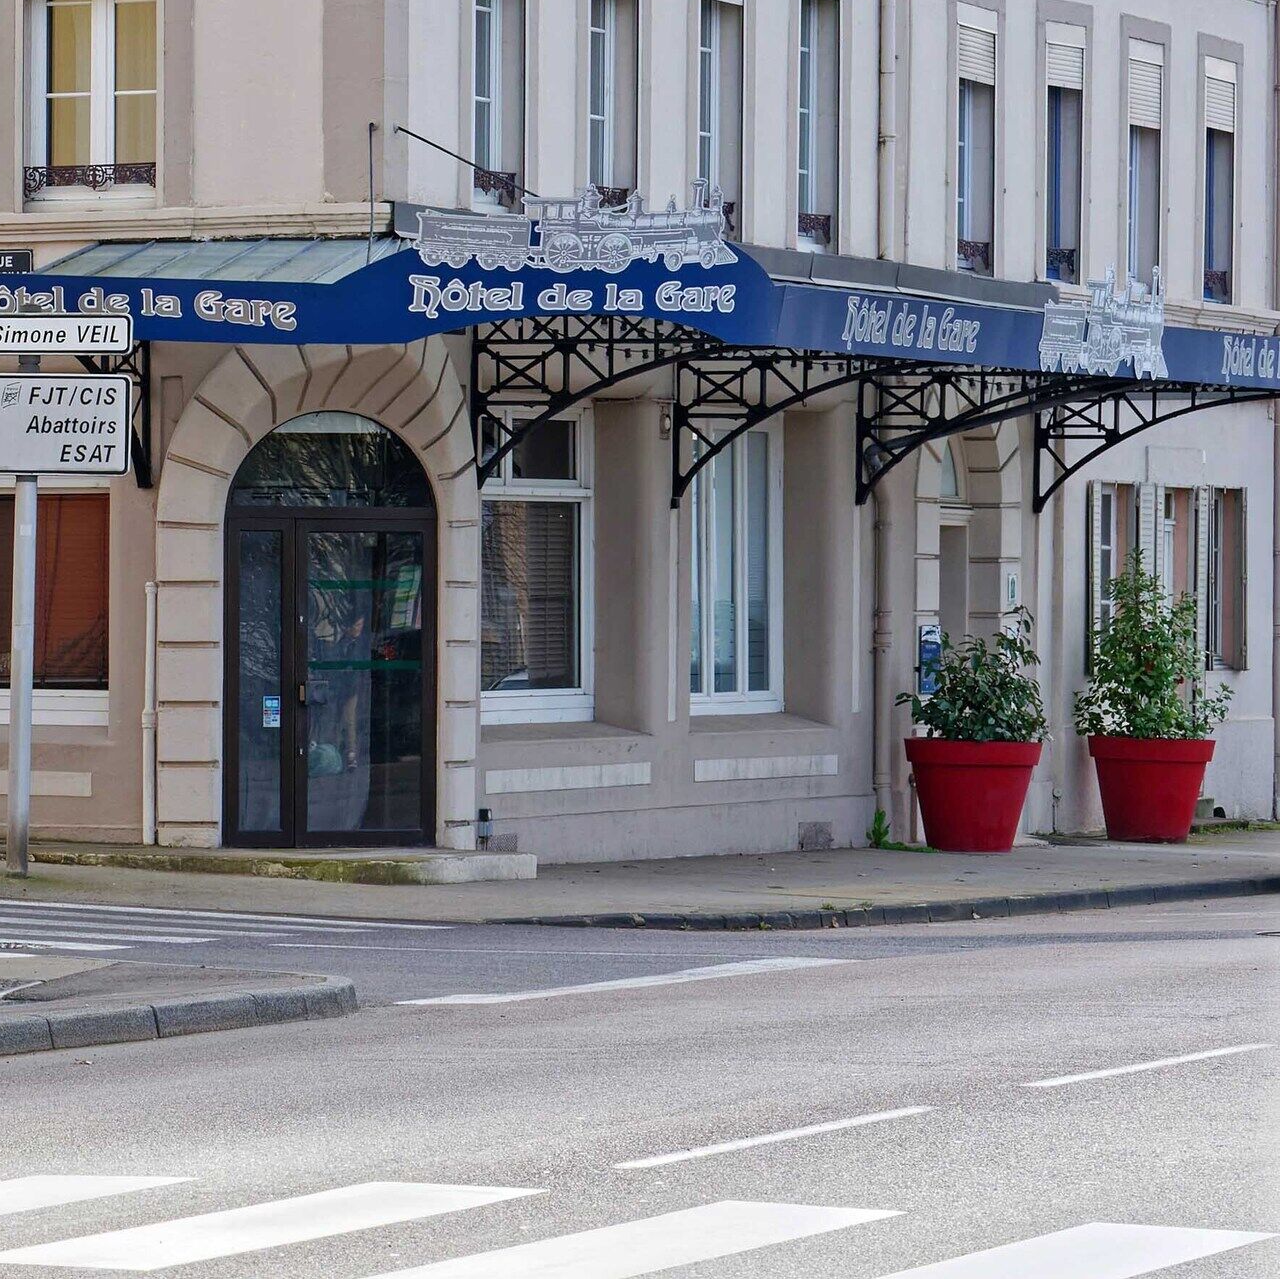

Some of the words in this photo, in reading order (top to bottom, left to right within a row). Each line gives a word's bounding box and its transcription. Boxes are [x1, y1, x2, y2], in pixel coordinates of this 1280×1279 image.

[78, 287, 130, 315] de
[140, 288, 183, 318] la
[194, 289, 297, 331] Gare
[408, 274, 524, 319] Hôtel
[537, 283, 593, 312] de
[603, 283, 644, 312] la
[654, 280, 737, 314] Gare
[77, 324, 120, 344] VEIL
[841, 295, 893, 351] Hôtel
[891, 302, 918, 348] de
[916, 304, 937, 350] la
[937, 307, 981, 354] Gare
[1221, 335, 1256, 383] Hôtel
[1258, 339, 1275, 379] de
[28, 386, 117, 406] FJT/CIS
[25, 414, 117, 434] Abattoirs
[59, 444, 117, 463] ESAT
